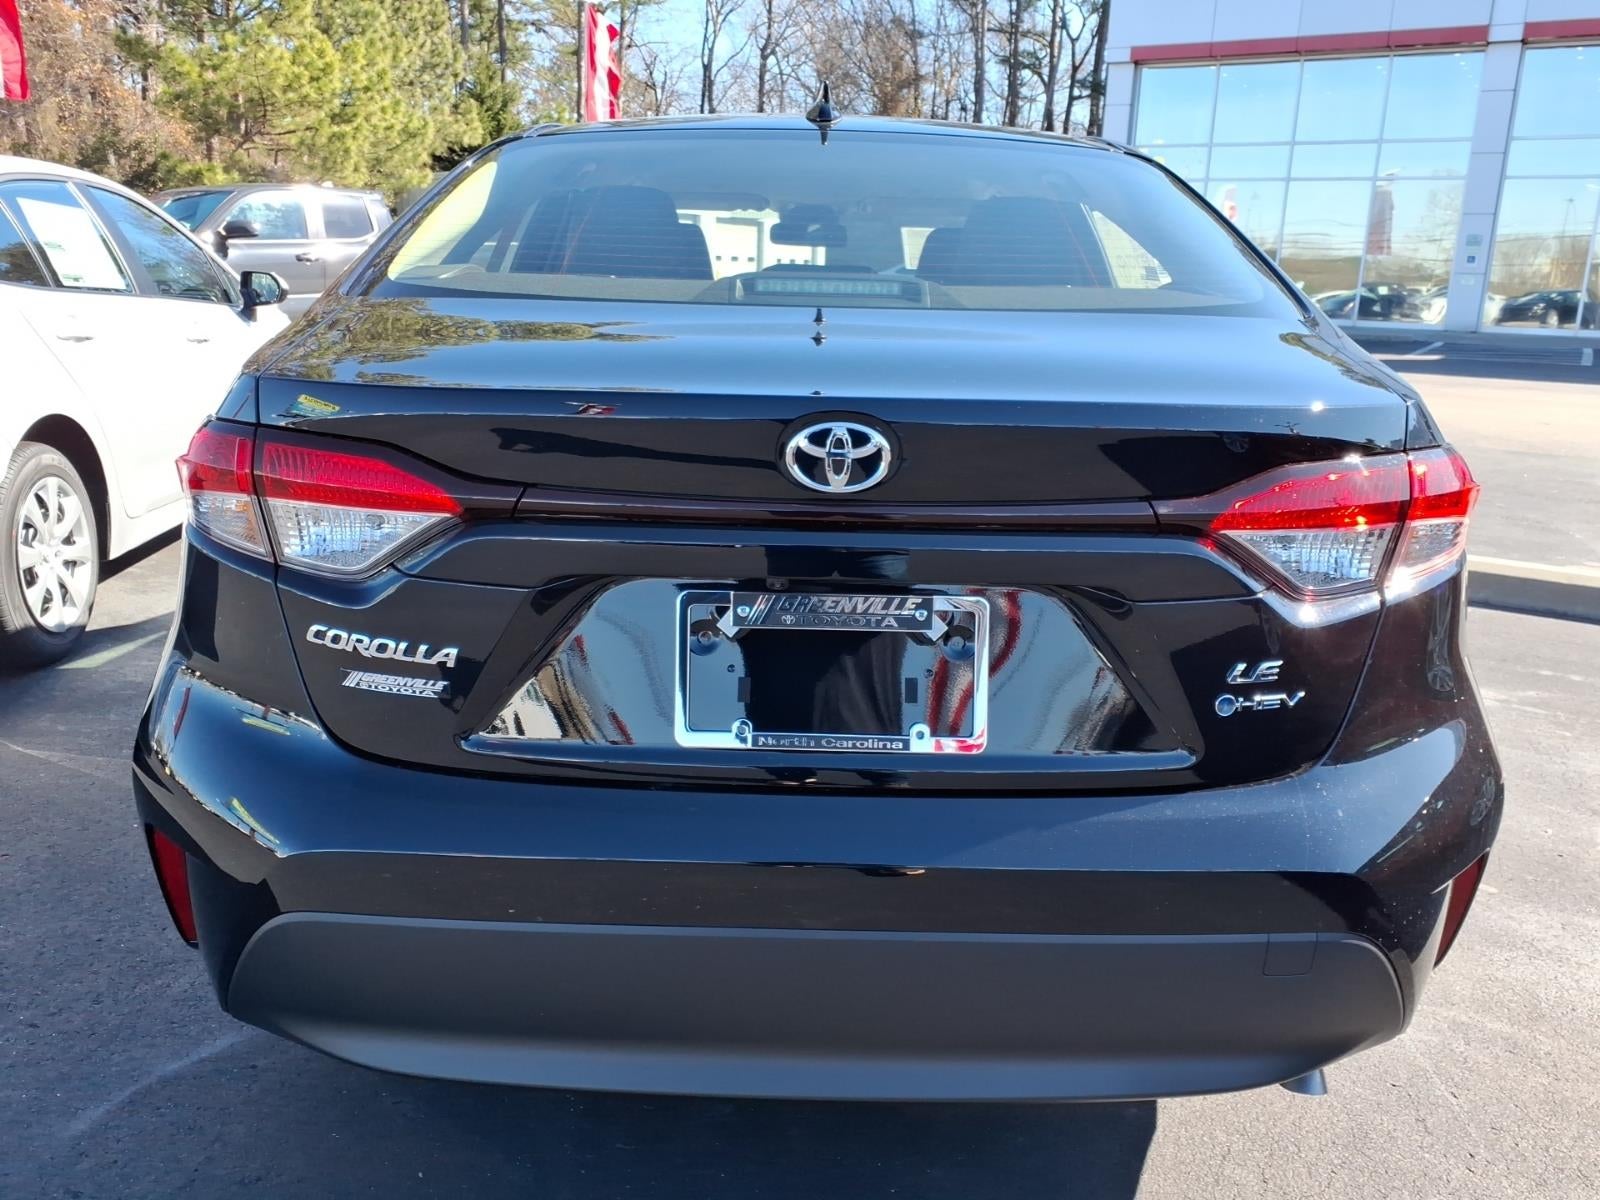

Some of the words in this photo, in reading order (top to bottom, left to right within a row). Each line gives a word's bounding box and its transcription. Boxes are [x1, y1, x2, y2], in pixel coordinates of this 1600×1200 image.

[796, 615, 898, 627] TOYOTA
[306, 624, 459, 668] COROLLA
[360, 672, 450, 691] GREENVILLE
[1226, 660, 1284, 684] LE
[369, 683, 435, 696] TOYOTA
[1236, 691, 1306, 712] HEV
[821, 738, 904, 749] Carolina
